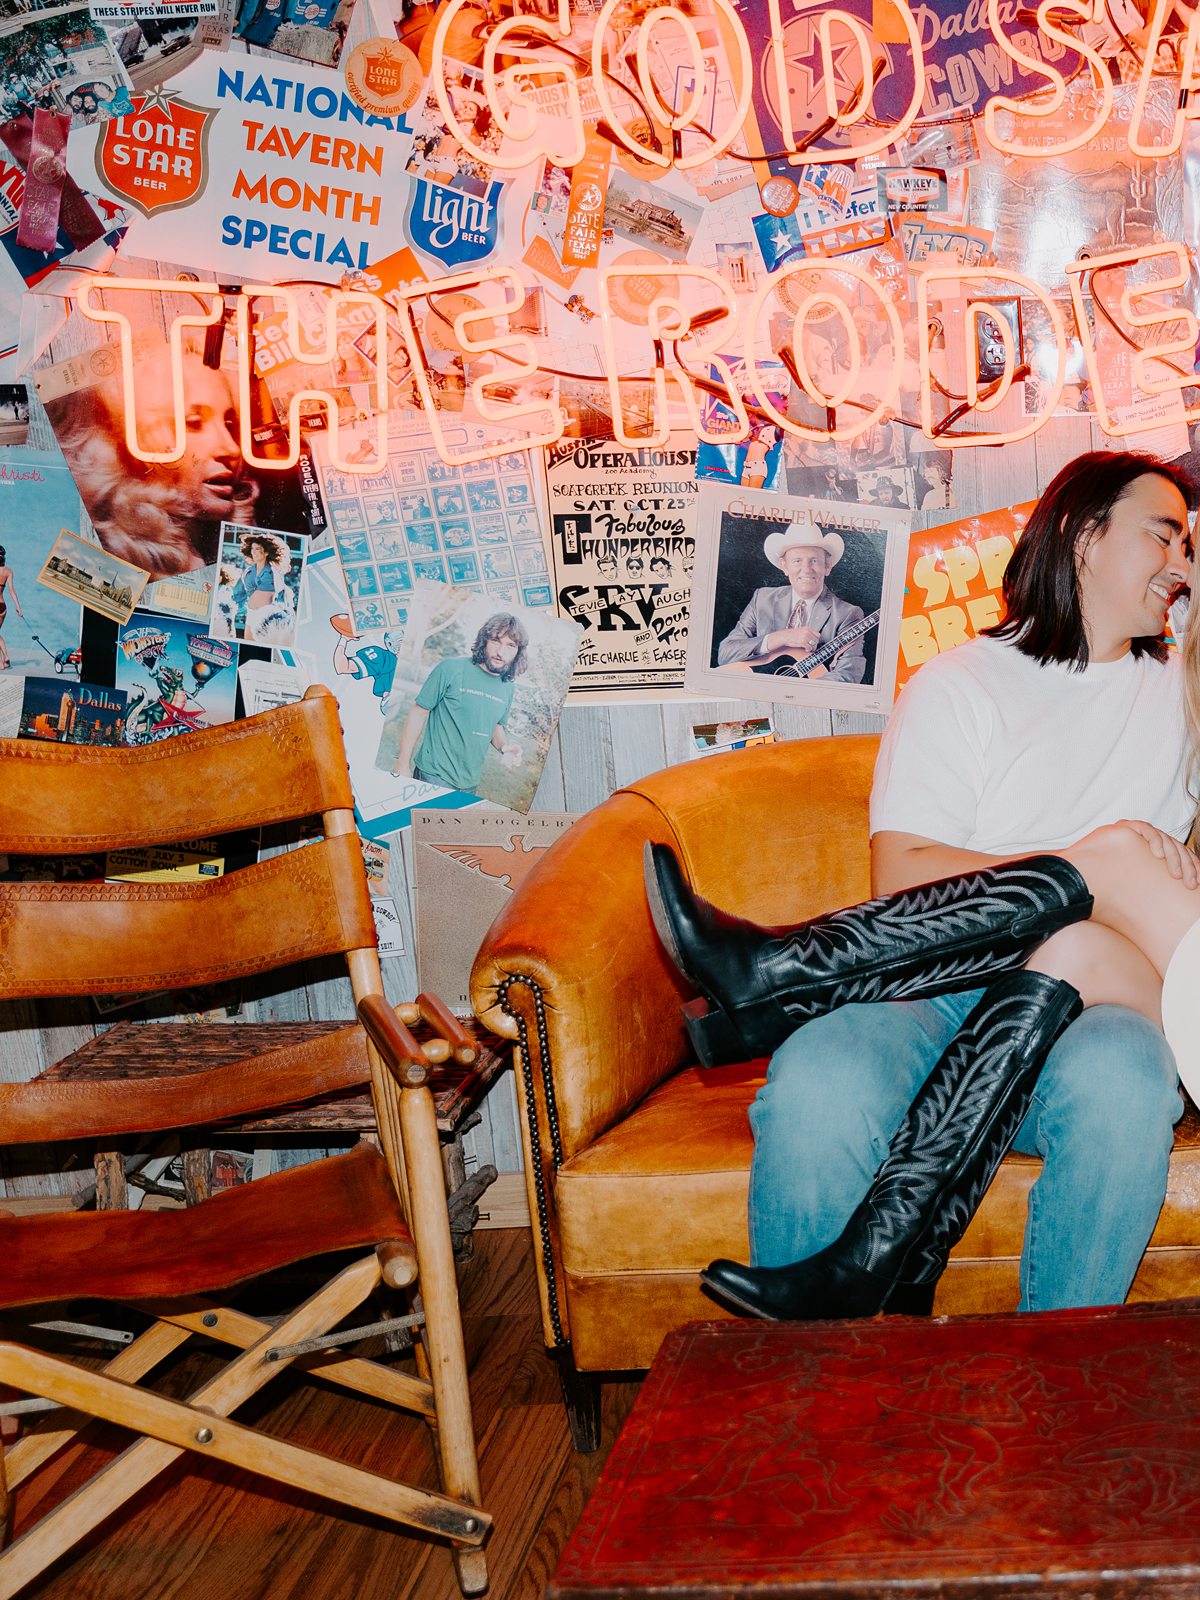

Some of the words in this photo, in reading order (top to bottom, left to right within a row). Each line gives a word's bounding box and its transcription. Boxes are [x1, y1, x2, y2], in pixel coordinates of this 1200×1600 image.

[93, 7, 119, 16] THESE
[120, 6, 155, 16] STRIPES
[155, 5, 174, 14] WILL
[175, 4, 199, 13] NEVER
[200, 3, 216, 12] RUN
[201, 24, 230, 34] TEXAS
[907, 0, 1022, 56] Dalla
[369, 65, 398, 77] LONE
[369, 75, 398, 86] STAR
[432, 0, 925, 168] GOD
[347, 71, 365, 104] certified
[364, 102, 400, 114] premium
[115, 116, 197, 150] LONE
[242, 119, 384, 177] TAVERN
[112, 144, 194, 179] STAR
[133, 176, 167, 191] BEER
[888, 179, 938, 188] HAWKEYE
[232, 168, 382, 226] MONTH
[422, 188, 494, 249] light
[570, 211, 600, 229] STATE
[803, 212, 812, 228] I
[461, 232, 487, 246] BEER
[570, 226, 597, 239] FAIR
[805, 219, 886, 254] TEXAS
[221, 214, 372, 271] SPECIAL
[568, 240, 597, 252] TEXAS
[77, 269, 566, 475] THE
[308, 418, 323, 427] TEXAS
[706, 418, 741, 431] GIANT
[0, 464, 46, 482] hristi
[300, 454, 315, 485] RODEO
[619, 468, 657, 479] Academy
[633, 481, 699, 496] REUNION
[574, 500, 616, 512] SAT.
[624, 499, 665, 512] OCT.
[727, 496, 806, 527] CHARLIE
[808, 508, 883, 533] WALKER
[595, 513, 686, 538] Fabulous
[553, 514, 695, 565] THUNDERBIRD
[635, 632, 651, 644] AND
[365, 646, 377, 660] 12
[600, 650, 639, 665] CHARLIE
[79, 687, 122, 711] Dallas
[421, 817, 462, 825] DAN
[109, 855, 148, 868] COTTON
[151, 861, 179, 872] BOWL
[154, 852, 175, 861] JULY
[376, 906, 396, 922] COWBOY
